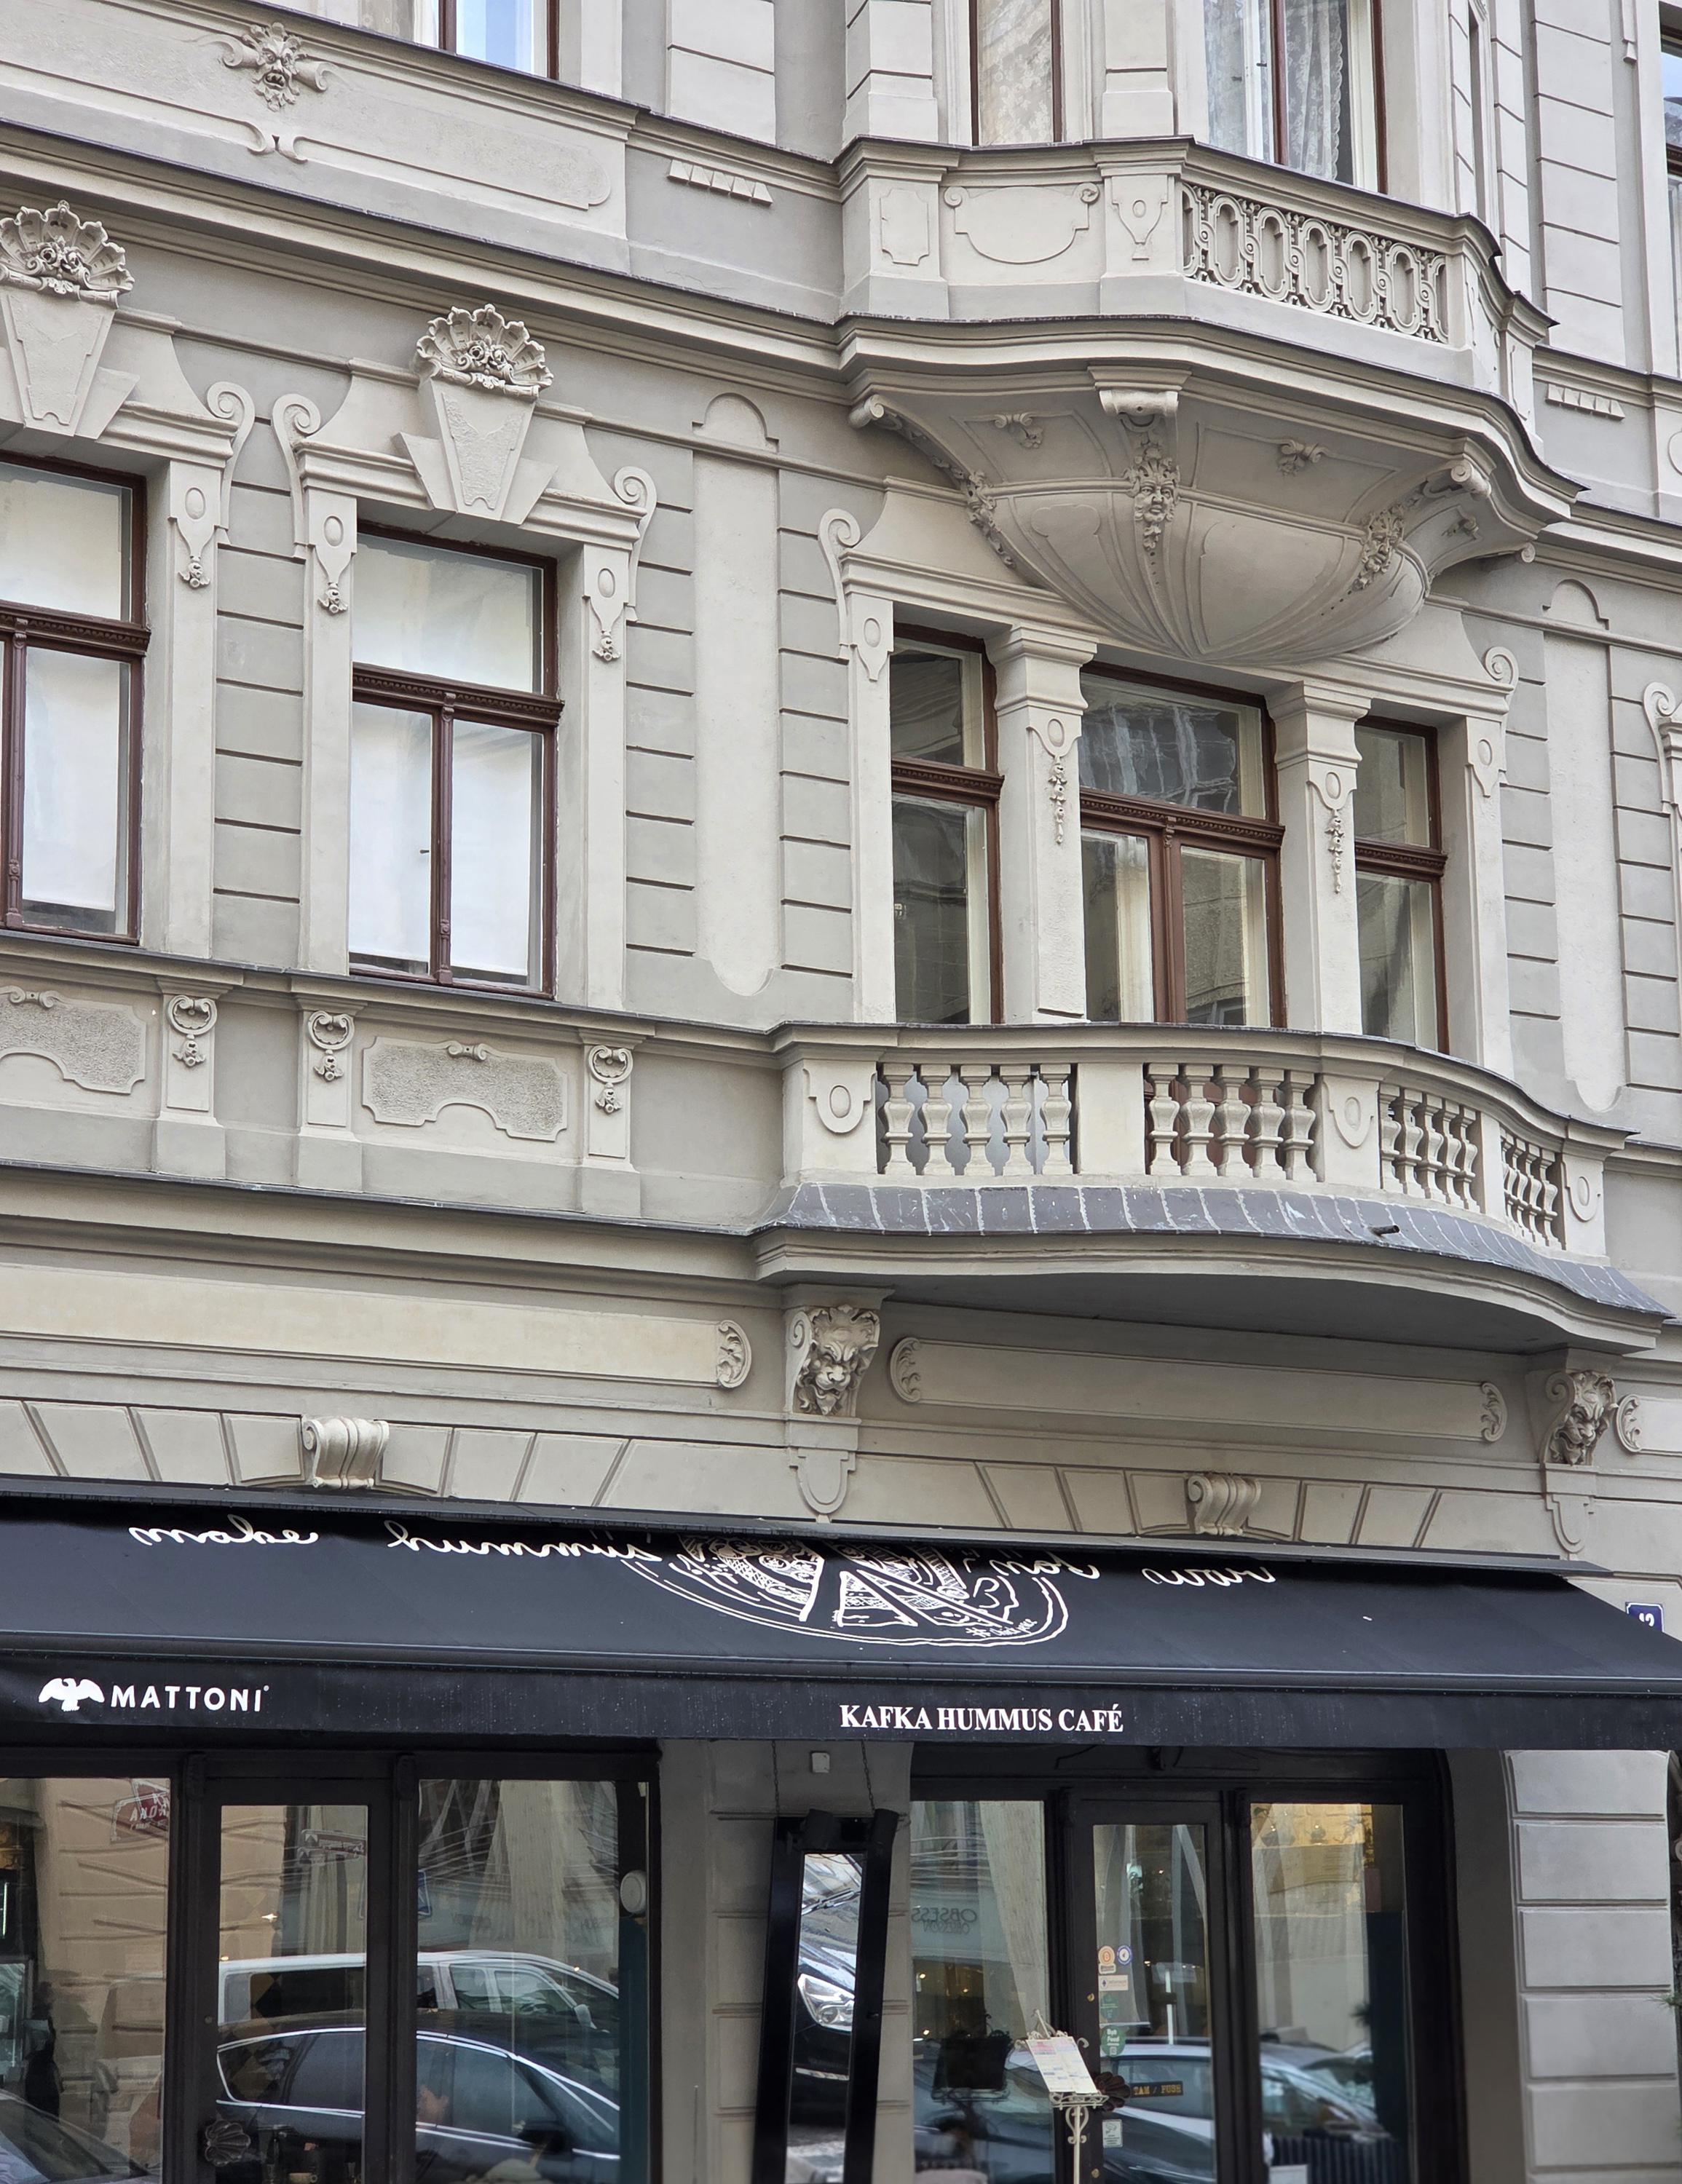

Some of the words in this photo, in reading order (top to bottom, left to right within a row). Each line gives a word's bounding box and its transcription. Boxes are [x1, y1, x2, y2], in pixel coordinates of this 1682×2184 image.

[384, 1520, 663, 1562] hummus
[111, 1685, 261, 1712] MATTONI
[840, 1704, 933, 1730] KAFKA
[937, 1707, 1052, 1730] HUMMUS
[1058, 1704, 1124, 1733] CAFÉ
